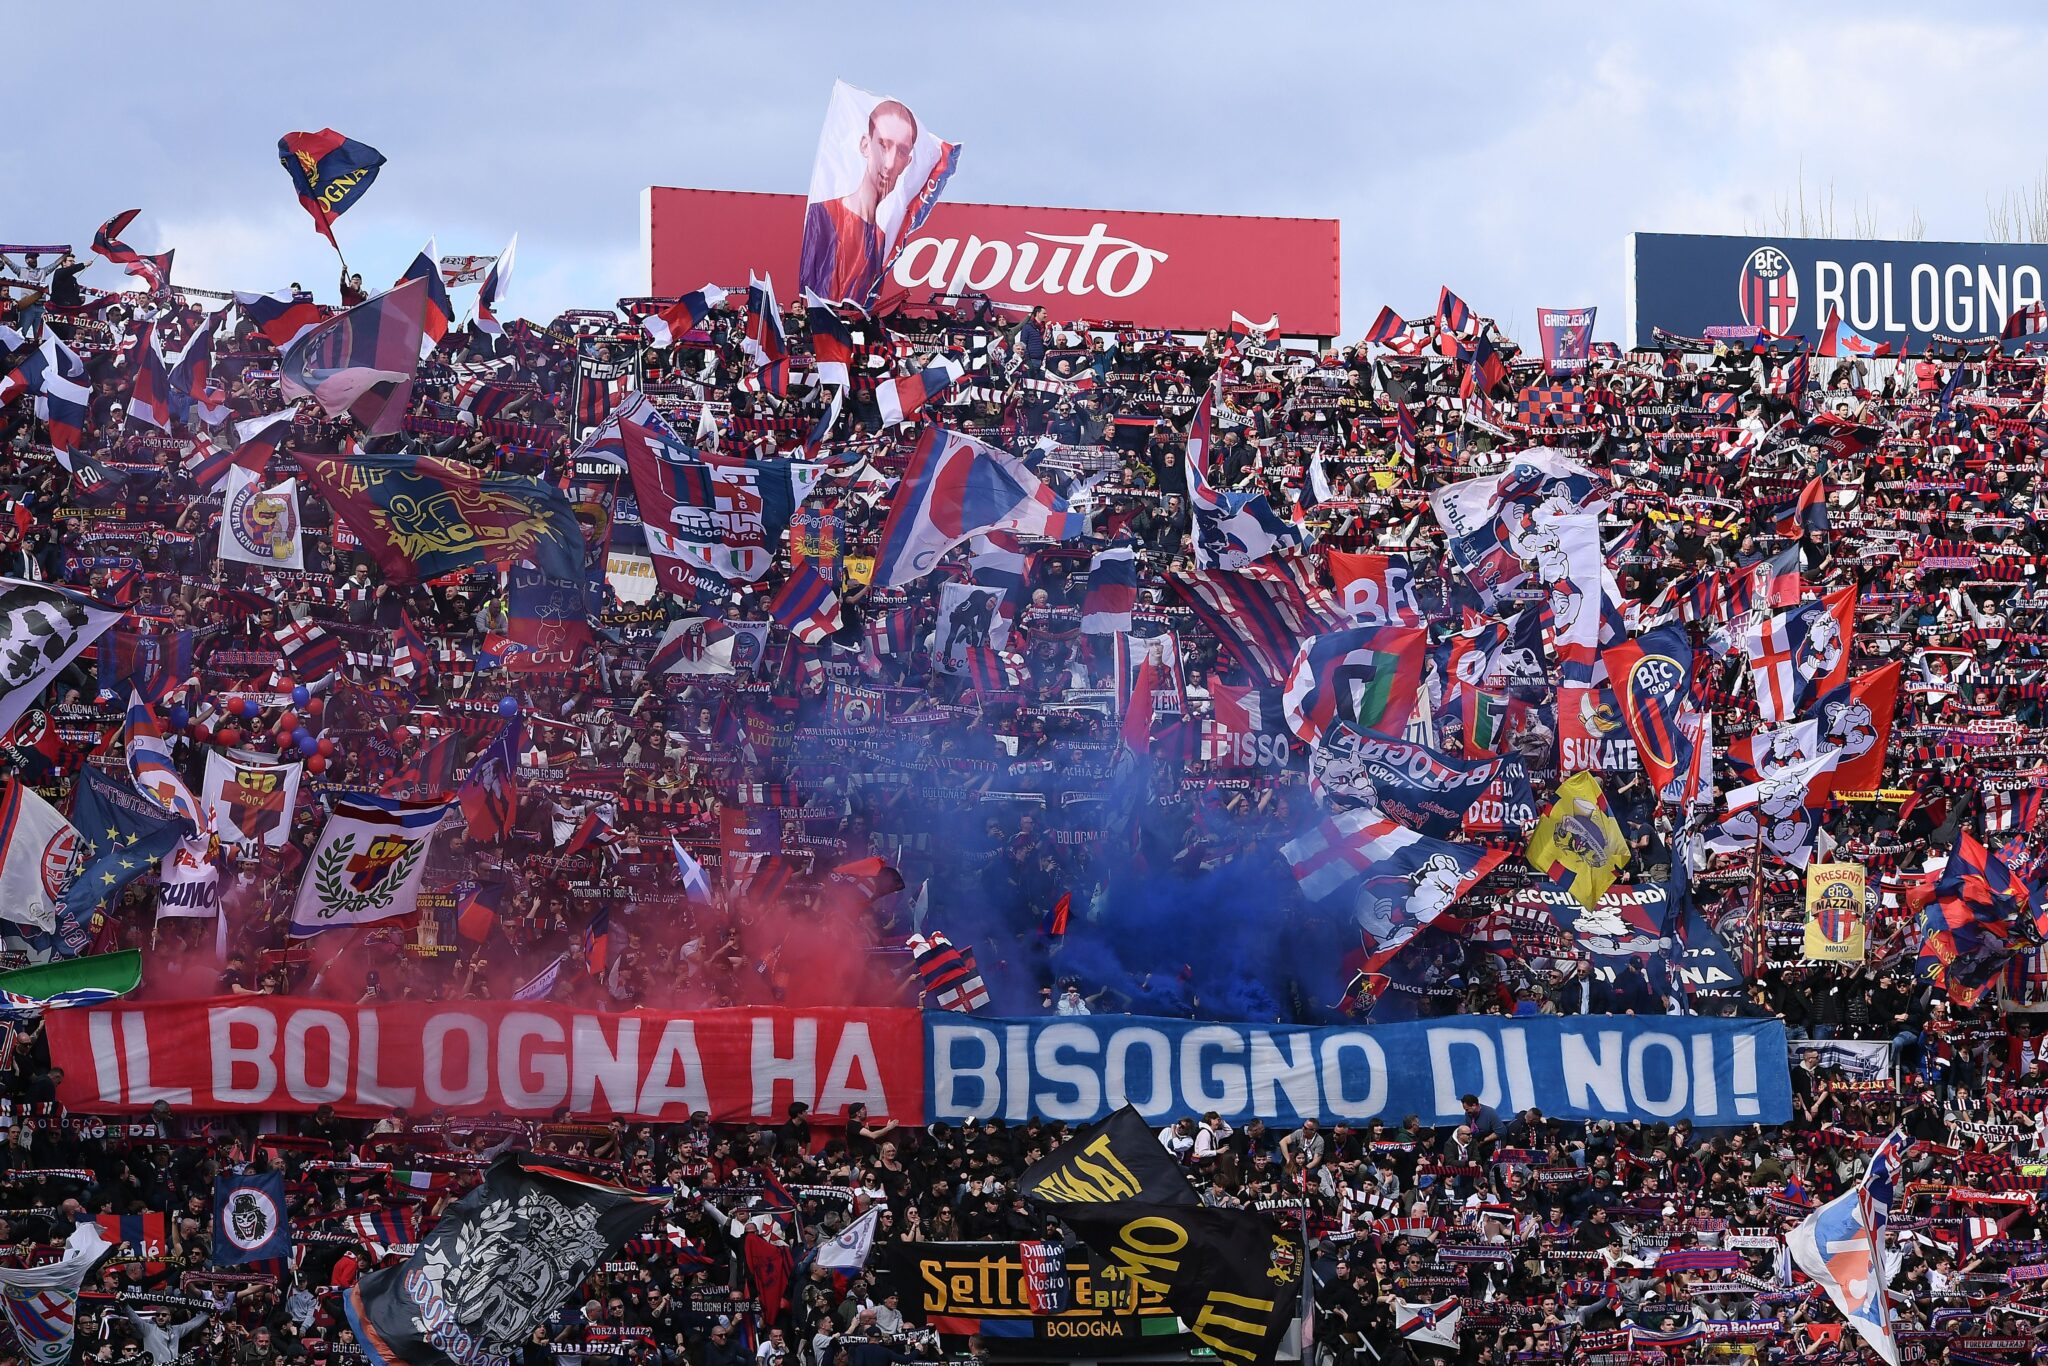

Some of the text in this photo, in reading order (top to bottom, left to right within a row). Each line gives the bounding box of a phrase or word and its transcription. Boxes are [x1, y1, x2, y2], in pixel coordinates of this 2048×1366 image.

[316, 166, 369, 215] OGNA
[893, 223, 1169, 306] aputo
[1755, 251, 1783, 270] BFC
[1815, 260, 2044, 333] BOLOGNA
[43, 314, 111, 334] ORZA BOLOGN
[1544, 314, 1591, 327] GHISILIERA
[1551, 359, 1587, 369] PRESENTE
[1216, 410, 1255, 428] BOLOGN
[1532, 425, 1595, 435] BOLOGNA
[576, 462, 622, 475] BOLOGNA
[1096, 487, 1123, 496] Bologna
[1144, 489, 1158, 498] fede
[1900, 509, 1928, 520] BOLOGN
[230, 489, 271, 557] FOREVER SCHULTZ
[682, 526, 760, 541] BOLOGNA F.C.
[1994, 545, 2024, 555] MERD
[1343, 567, 1418, 628] BFC
[690, 624, 702, 635] BFC
[727, 621, 766, 630] ARGELATO
[825, 665, 860, 676] OGNA
[1636, 662, 1673, 689] BFC
[1510, 676, 1530, 686] SIAMO
[834, 684, 882, 699] BOLOGNA
[1648, 681, 1670, 695] 1909
[1151, 690, 1180, 711] ZLÈIN
[464, 702, 499, 713] BOLO
[1949, 702, 1966, 713] ORZA
[1563, 736, 1638, 770] SUKATE
[517, 768, 539, 779] OLOGNA
[550, 770, 564, 780] 1909
[1504, 761, 1525, 778] ITA
[237, 771, 275, 793] CTB
[1183, 779, 1205, 789] UVE
[1490, 779, 1513, 797] TE LA
[544, 784, 563, 795] VE
[1840, 791, 1873, 800] VECCHIA
[239, 791, 265, 807] 2004
[1468, 800, 1532, 826] DEDICO
[733, 827, 761, 836] ORGOGLIO
[369, 841, 405, 858] CTB
[159, 880, 216, 908] RUMO
[1510, 888, 1667, 907] ECCHI GUARDI
[1828, 885, 1850, 897] BFC
[434, 899, 457, 907] GALLI
[1816, 897, 1860, 911] MAZZINI
[1825, 945, 1848, 953] MMXV
[1392, 981, 1453, 996] BUCCE 2002
[88, 1005, 1761, 1121] IL BOLOGNA HA BISOGNO DI NOI!
[1832, 1080, 1886, 1090] MAZZINI
[1539, 1171, 1574, 1181] BOLOGNA
[1254, 1198, 1311, 1209] BOLOGNA
[292, 1230, 358, 1244] di Bologna
[606, 1261, 639, 1272] BOLOG
[1029, 1277, 1064, 1289] Nostro
[1576, 1281, 1607, 1295] 1974
[122, 1292, 215, 1309] HIAMATECI COME VOLETE
[692, 1301, 750, 1312] BOLOGNA FC 1909
[1047, 1321, 1123, 1337] BOLOGNA
[1731, 1319, 1780, 1332] Bologna
[1964, 1339, 2026, 1348] FOREVER ULTRAS
